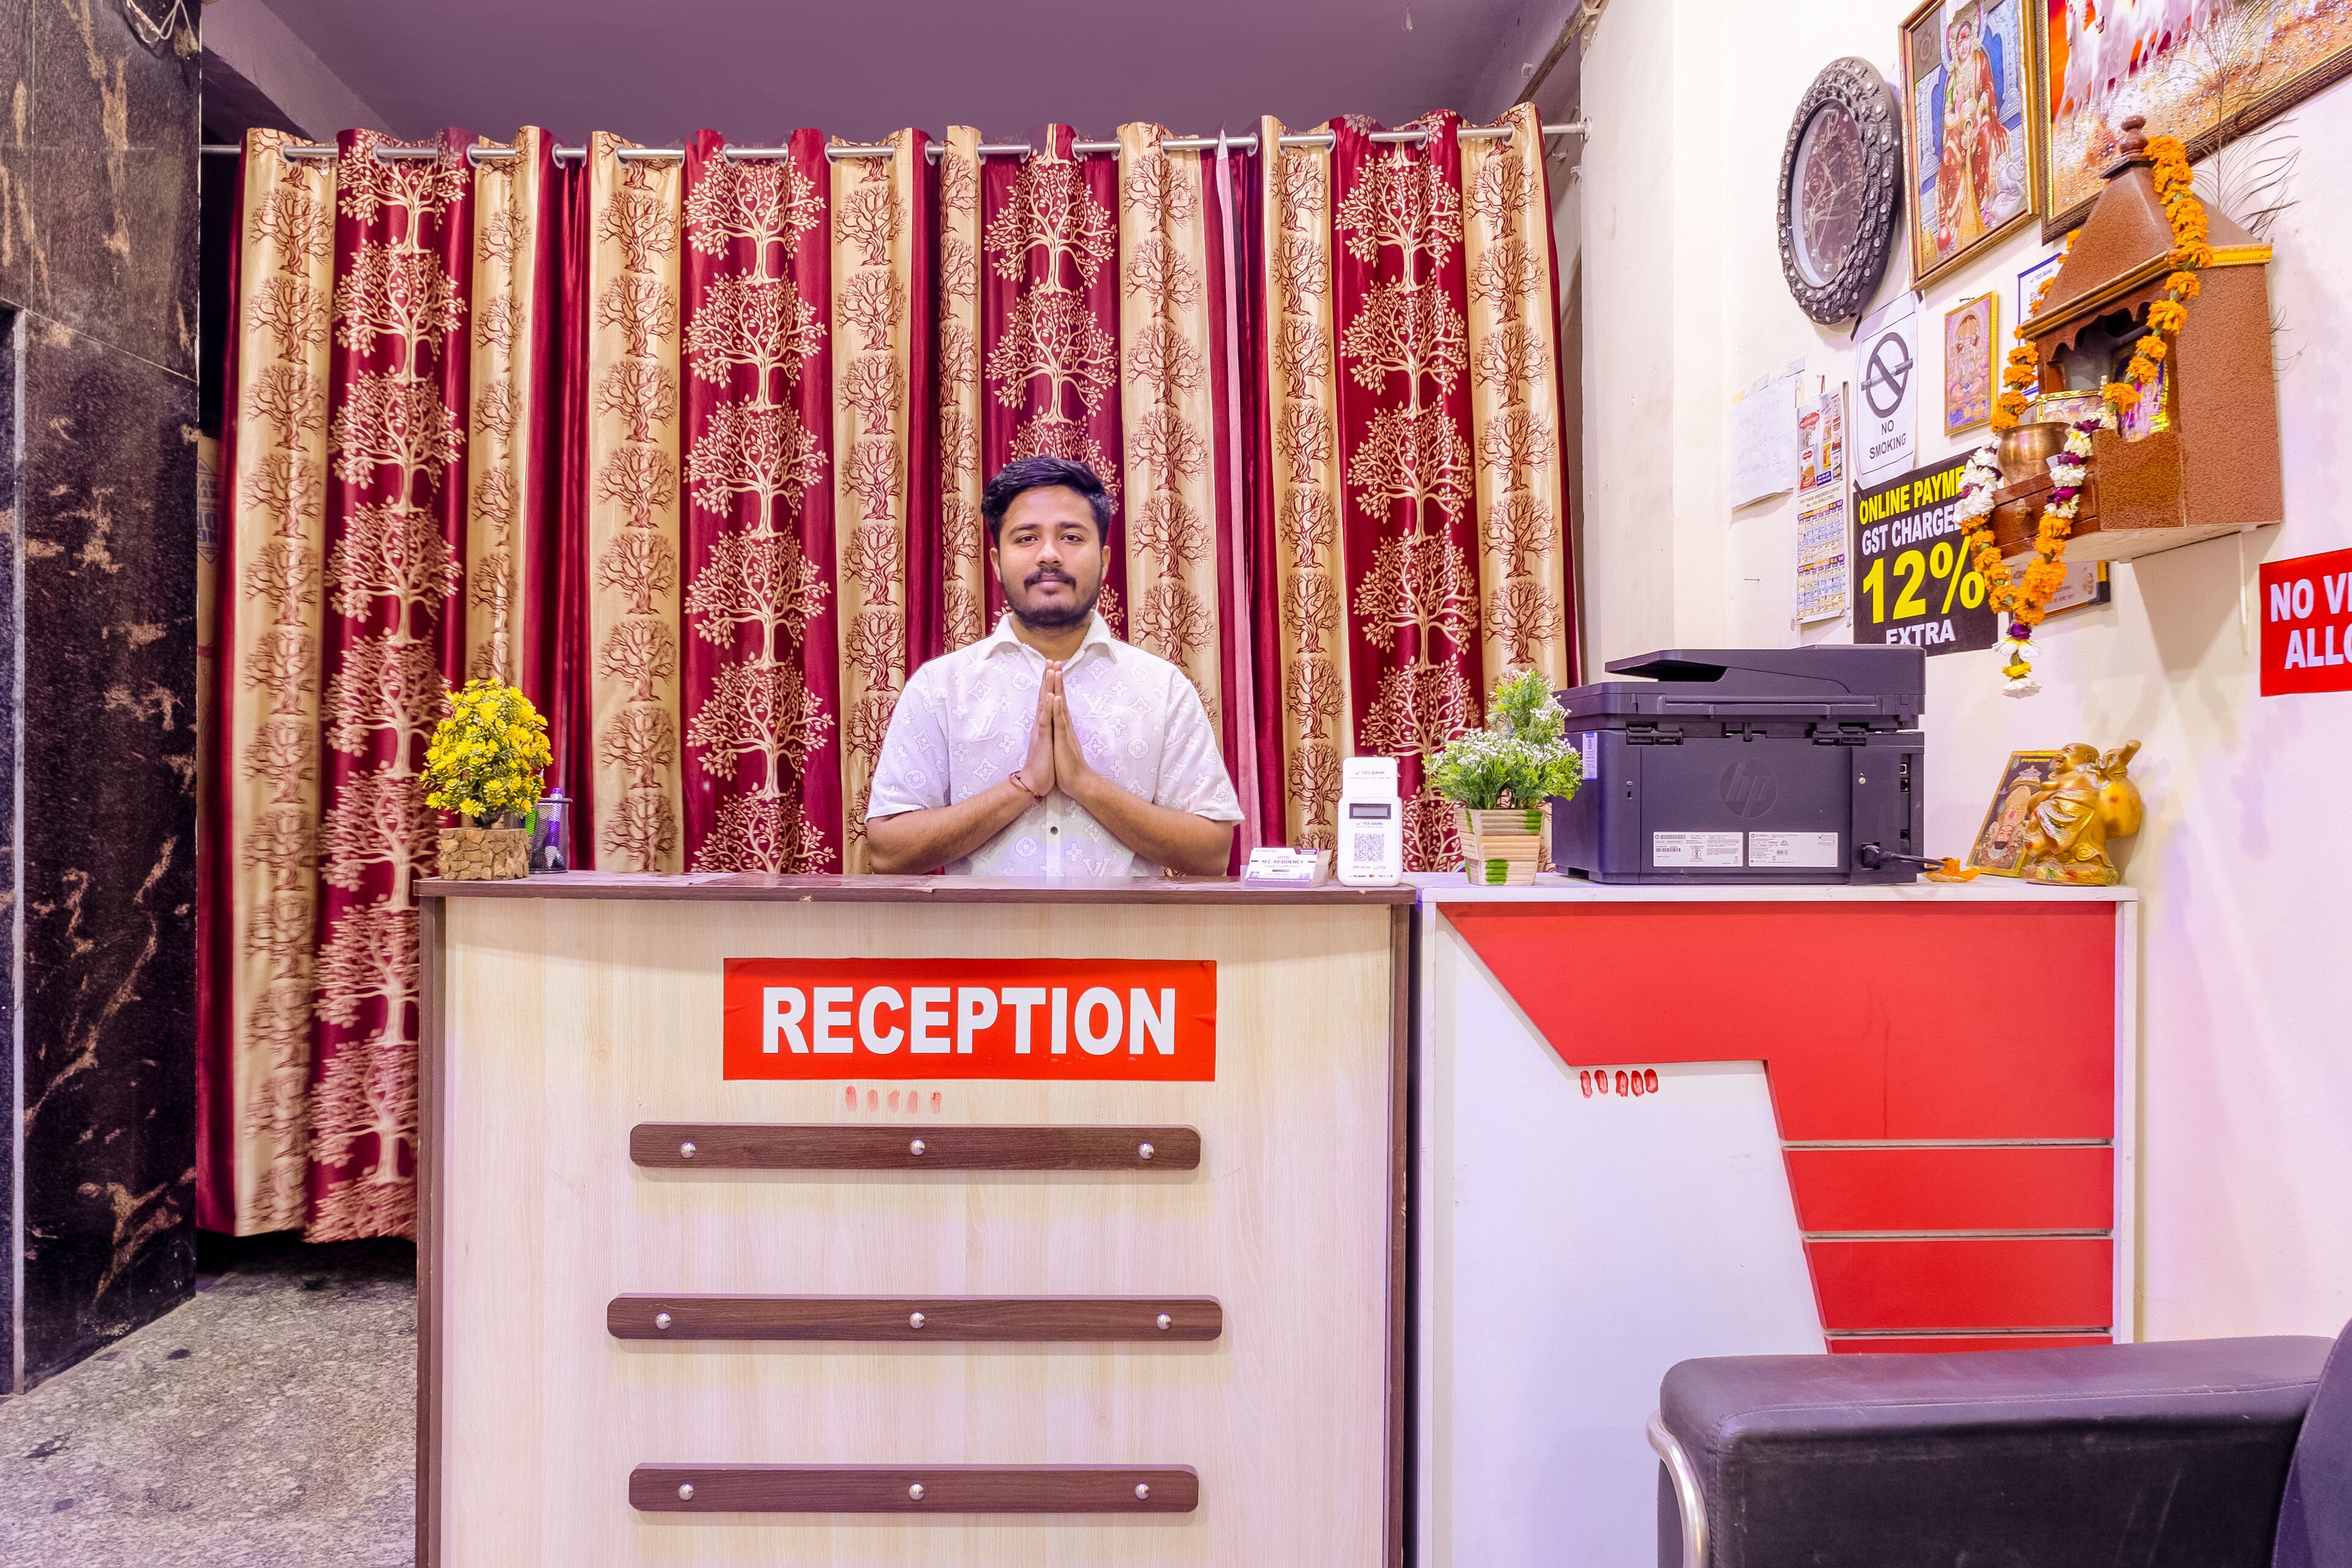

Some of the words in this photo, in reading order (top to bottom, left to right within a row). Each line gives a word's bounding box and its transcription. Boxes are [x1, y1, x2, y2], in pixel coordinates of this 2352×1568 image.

[1869, 432, 1906, 459] SMOKING
[1882, 420, 1894, 435] NO
[1859, 484, 1910, 525] ONLINE
[1913, 465, 1966, 508] PAYME
[1861, 524, 1889, 556] GST
[1863, 536, 1985, 624] 12%
[2271, 579, 2315, 622] NO
[1886, 619, 1956, 646] EXTRA
[763, 986, 1175, 1055] RECEPTION
